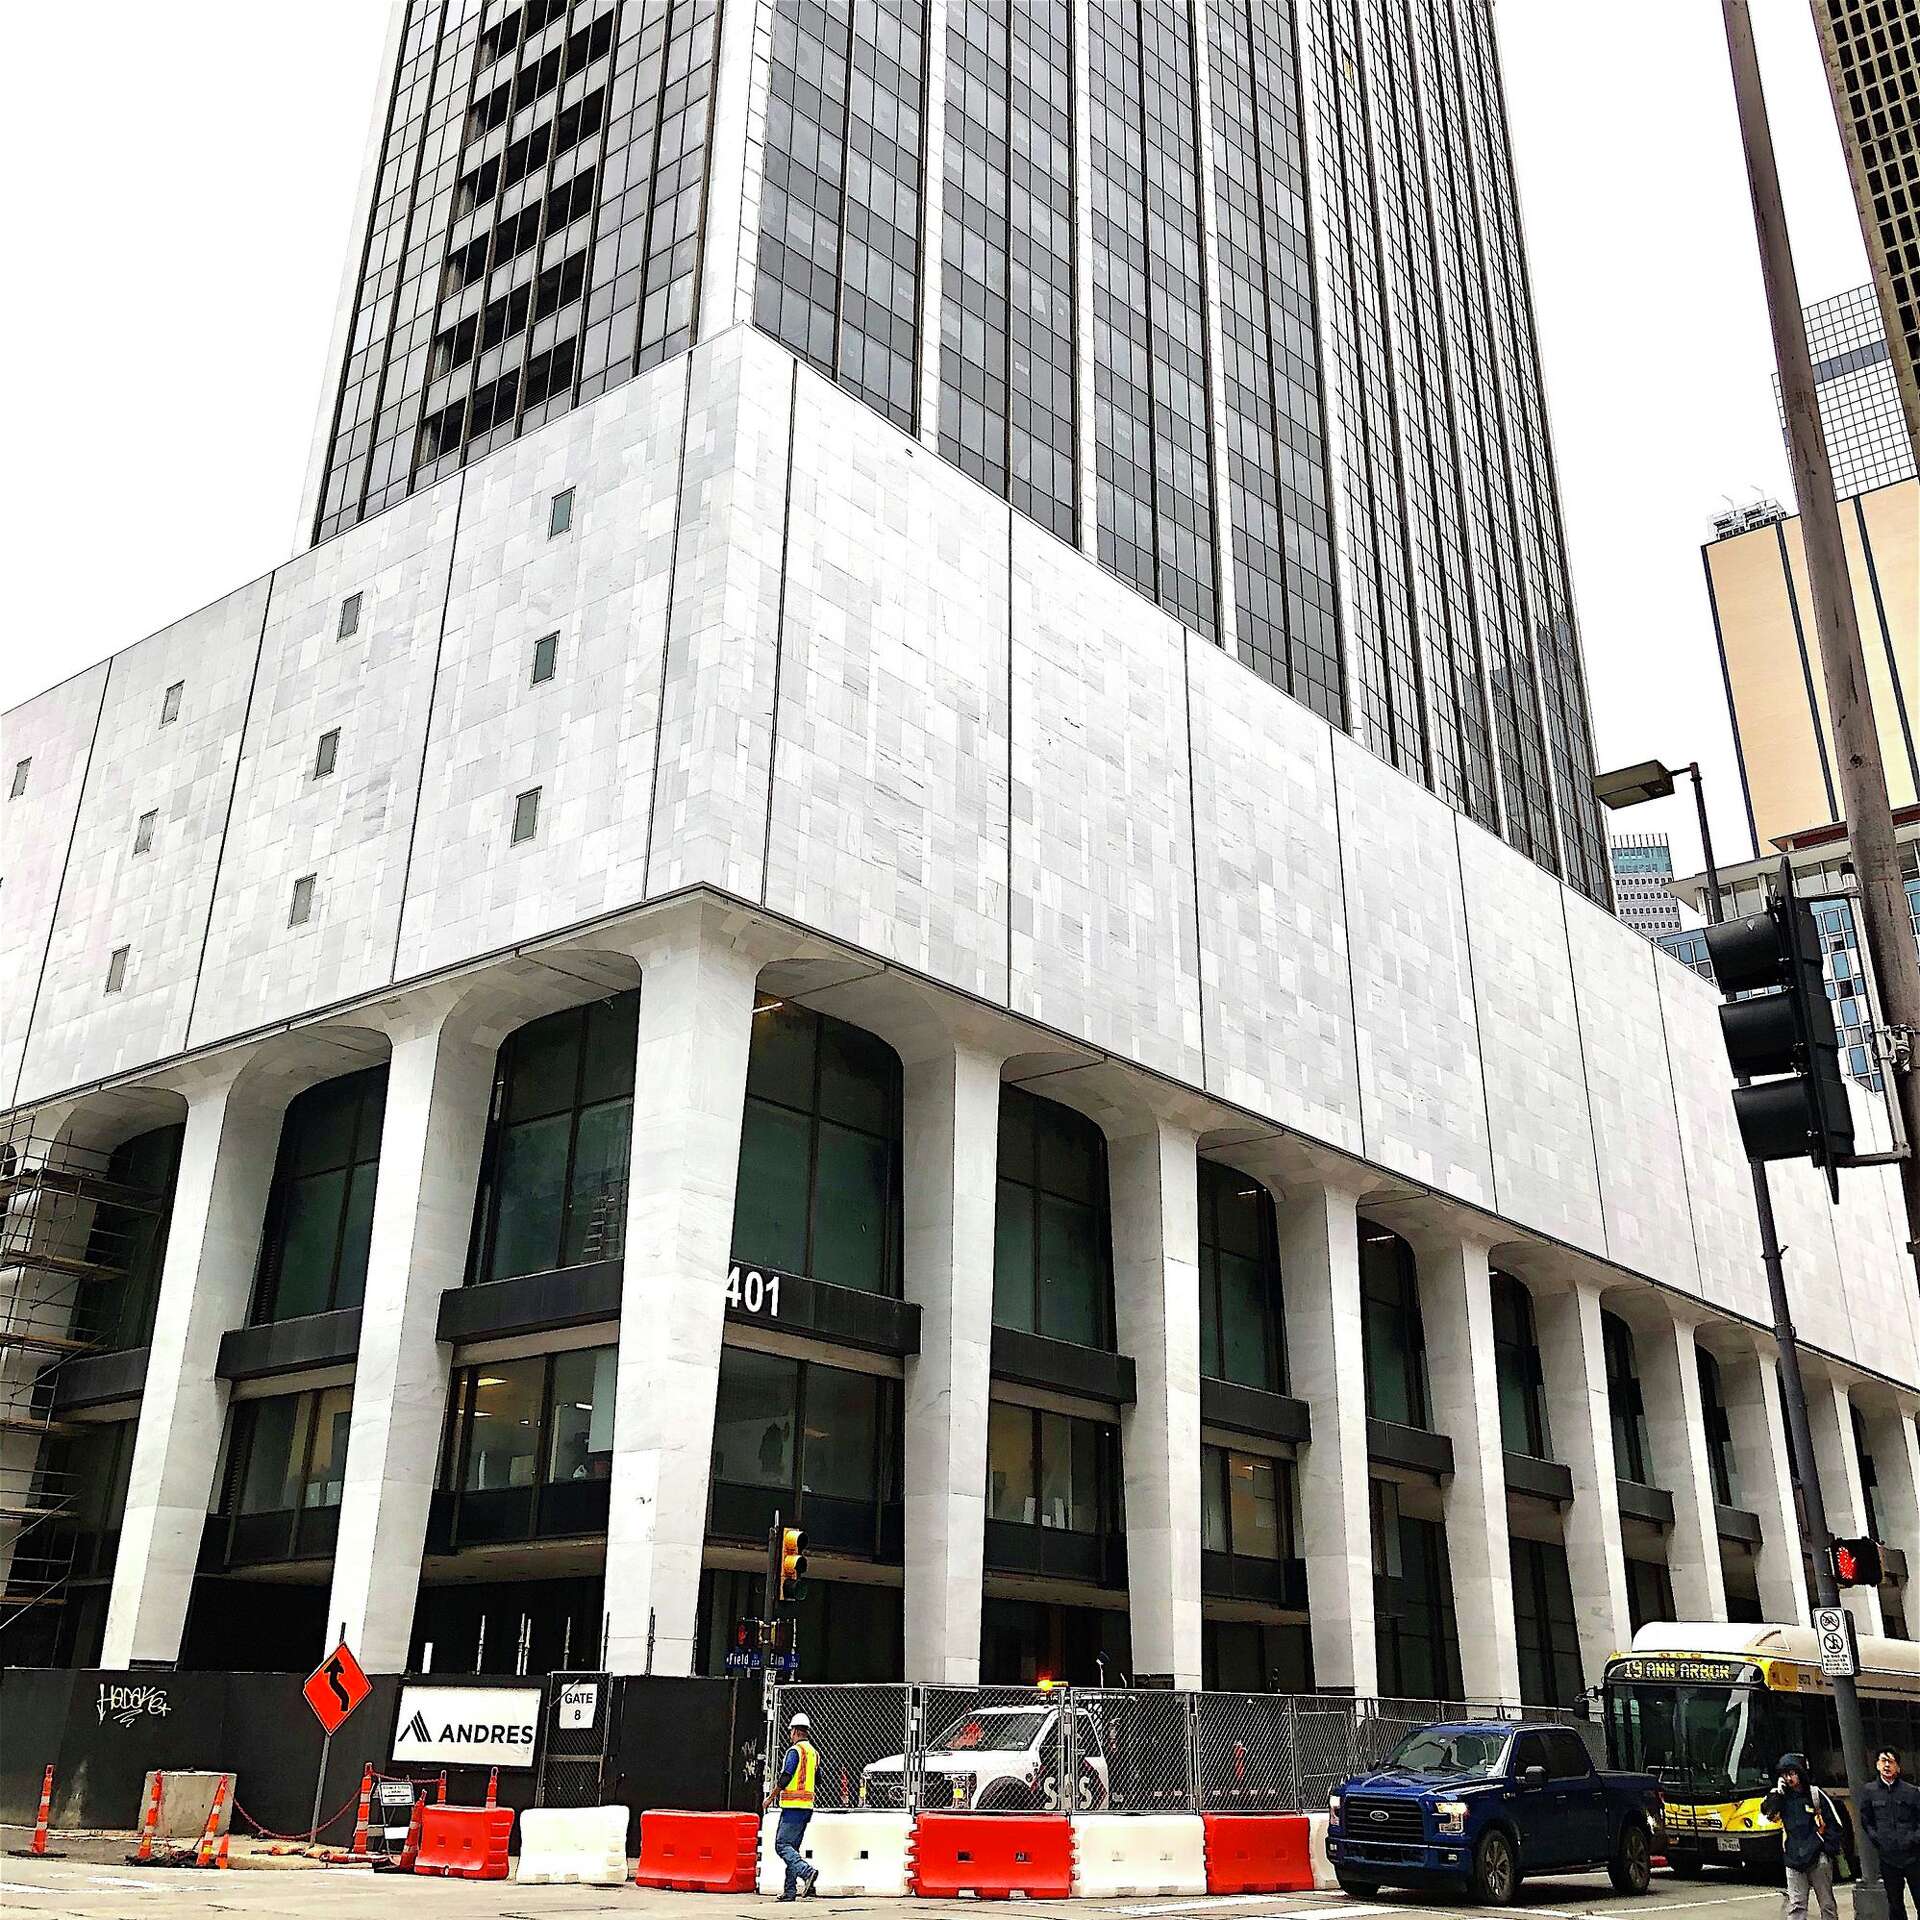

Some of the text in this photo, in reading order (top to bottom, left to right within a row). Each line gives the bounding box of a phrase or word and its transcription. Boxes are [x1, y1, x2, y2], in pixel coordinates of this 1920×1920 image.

[725, 1266, 780, 1317] 401
[728, 1653, 749, 1666] Field
[770, 1653, 785, 1667] Elm
[1624, 1660, 1730, 1679] 19 ANN ARBOR
[565, 1693, 593, 1704] GATE
[574, 1709, 581, 1720] 8
[438, 1724, 534, 1744] ANDRES
